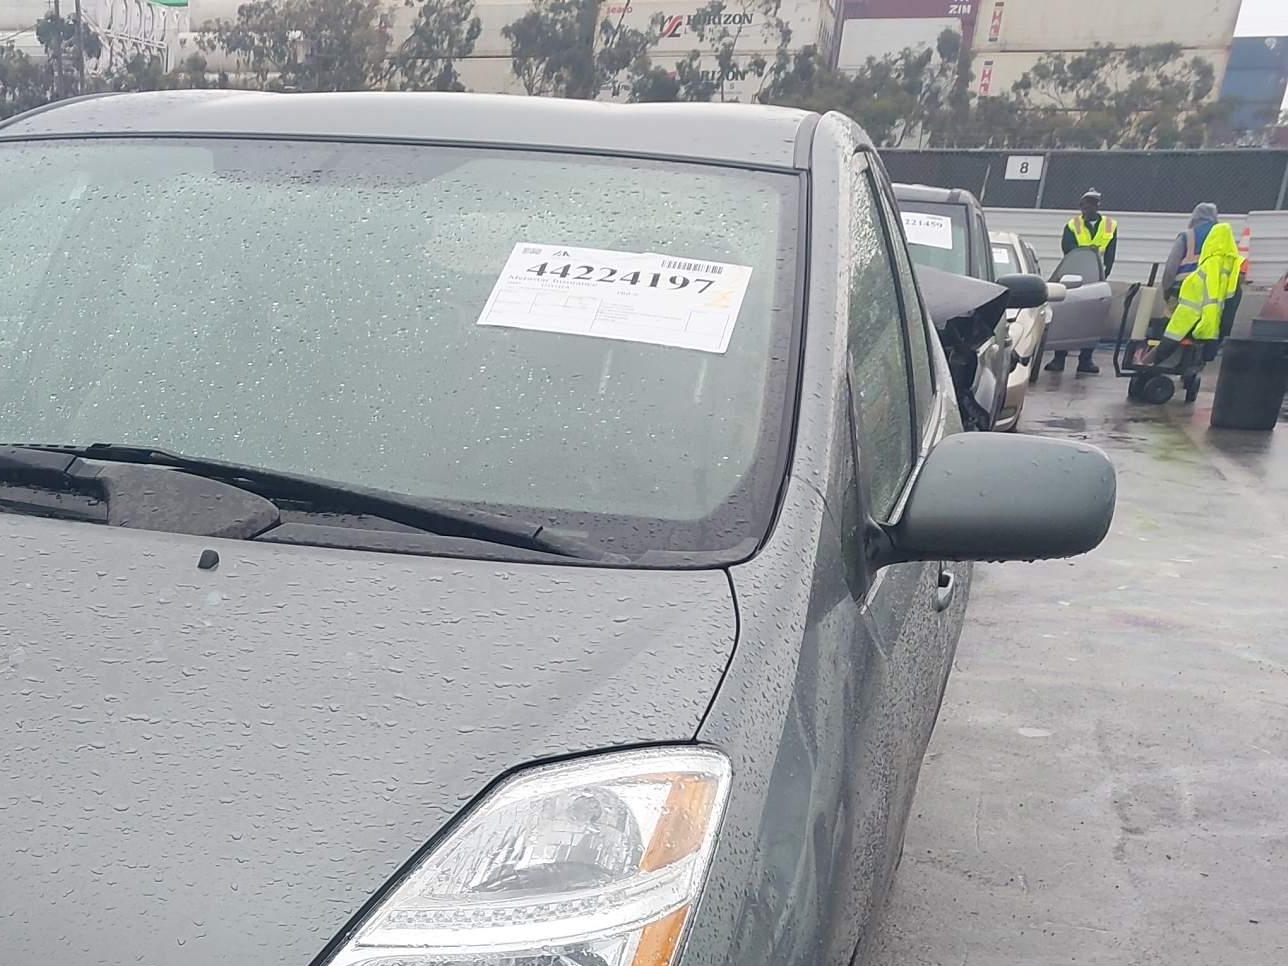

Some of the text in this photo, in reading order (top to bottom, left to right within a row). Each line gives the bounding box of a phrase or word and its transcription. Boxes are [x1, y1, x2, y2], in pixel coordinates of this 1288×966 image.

[948, 4, 972, 14] ZIM
[686, 13, 753, 25] HRIZON
[1020, 162, 1029, 174] 8
[526, 262, 716, 294] 44224197
